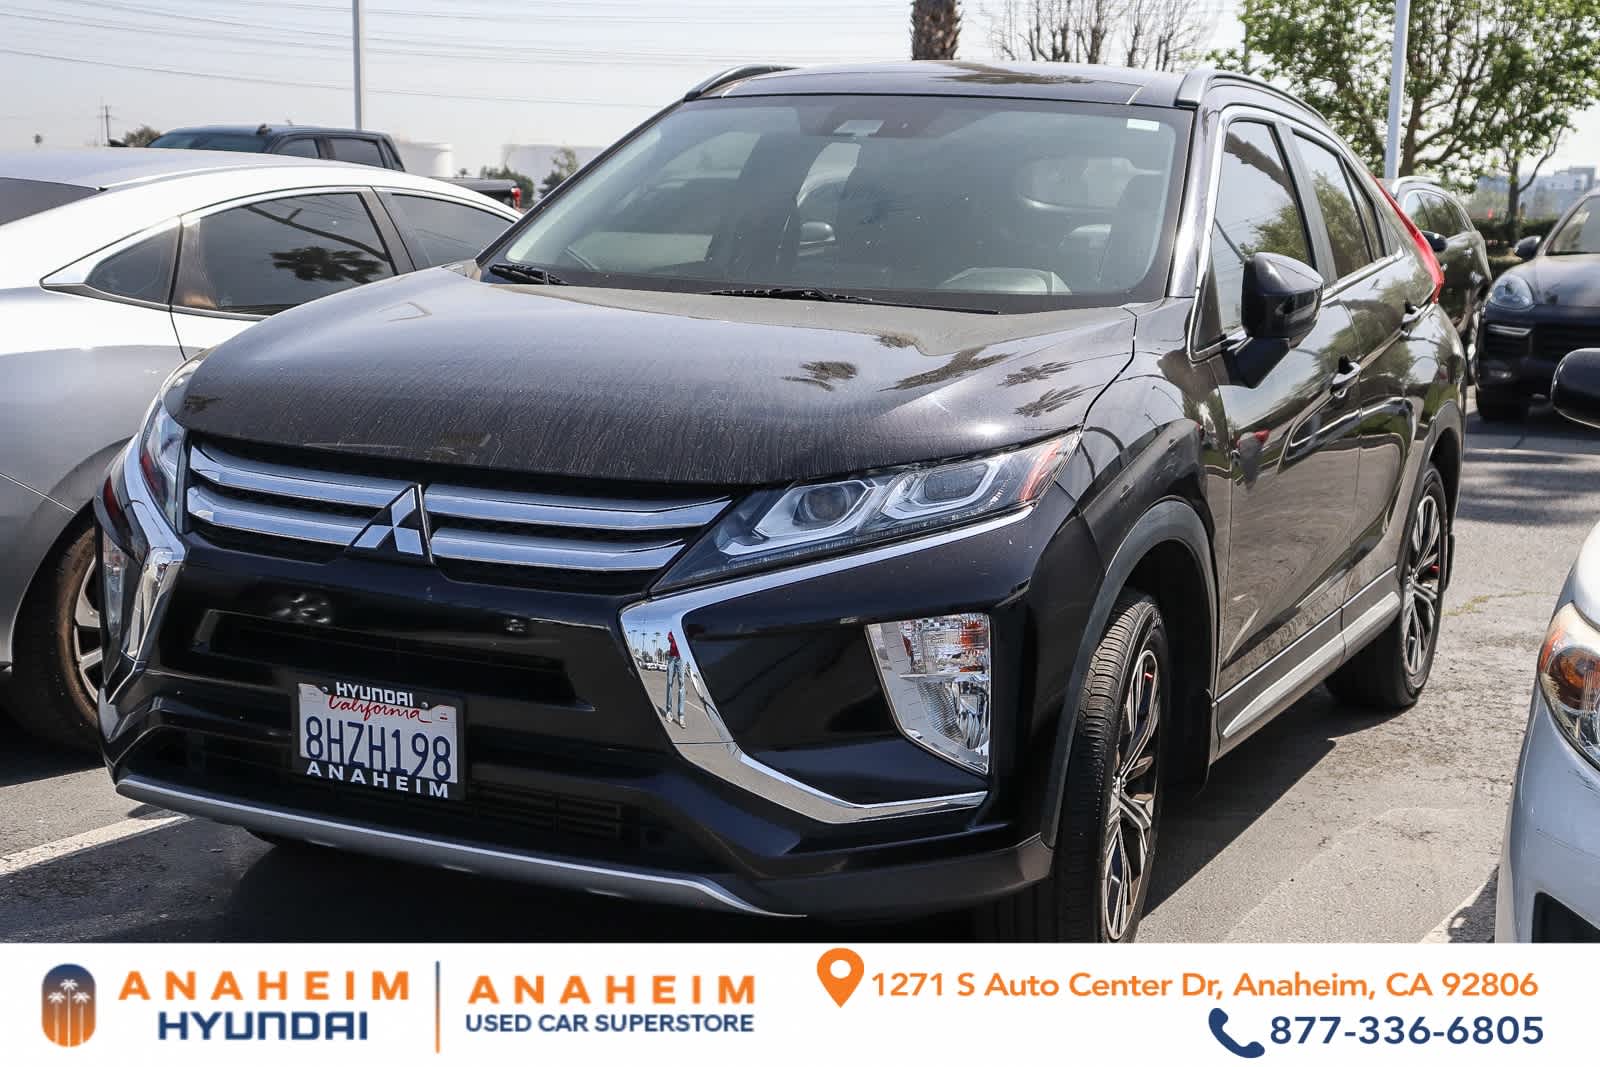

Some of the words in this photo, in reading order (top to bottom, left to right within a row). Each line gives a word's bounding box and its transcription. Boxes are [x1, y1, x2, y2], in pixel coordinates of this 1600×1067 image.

[328, 694, 432, 723] California
[336, 682, 414, 707] HYUNDAI
[306, 716, 451, 781] 8HZH198
[306, 760, 449, 799] ANAHEIM
